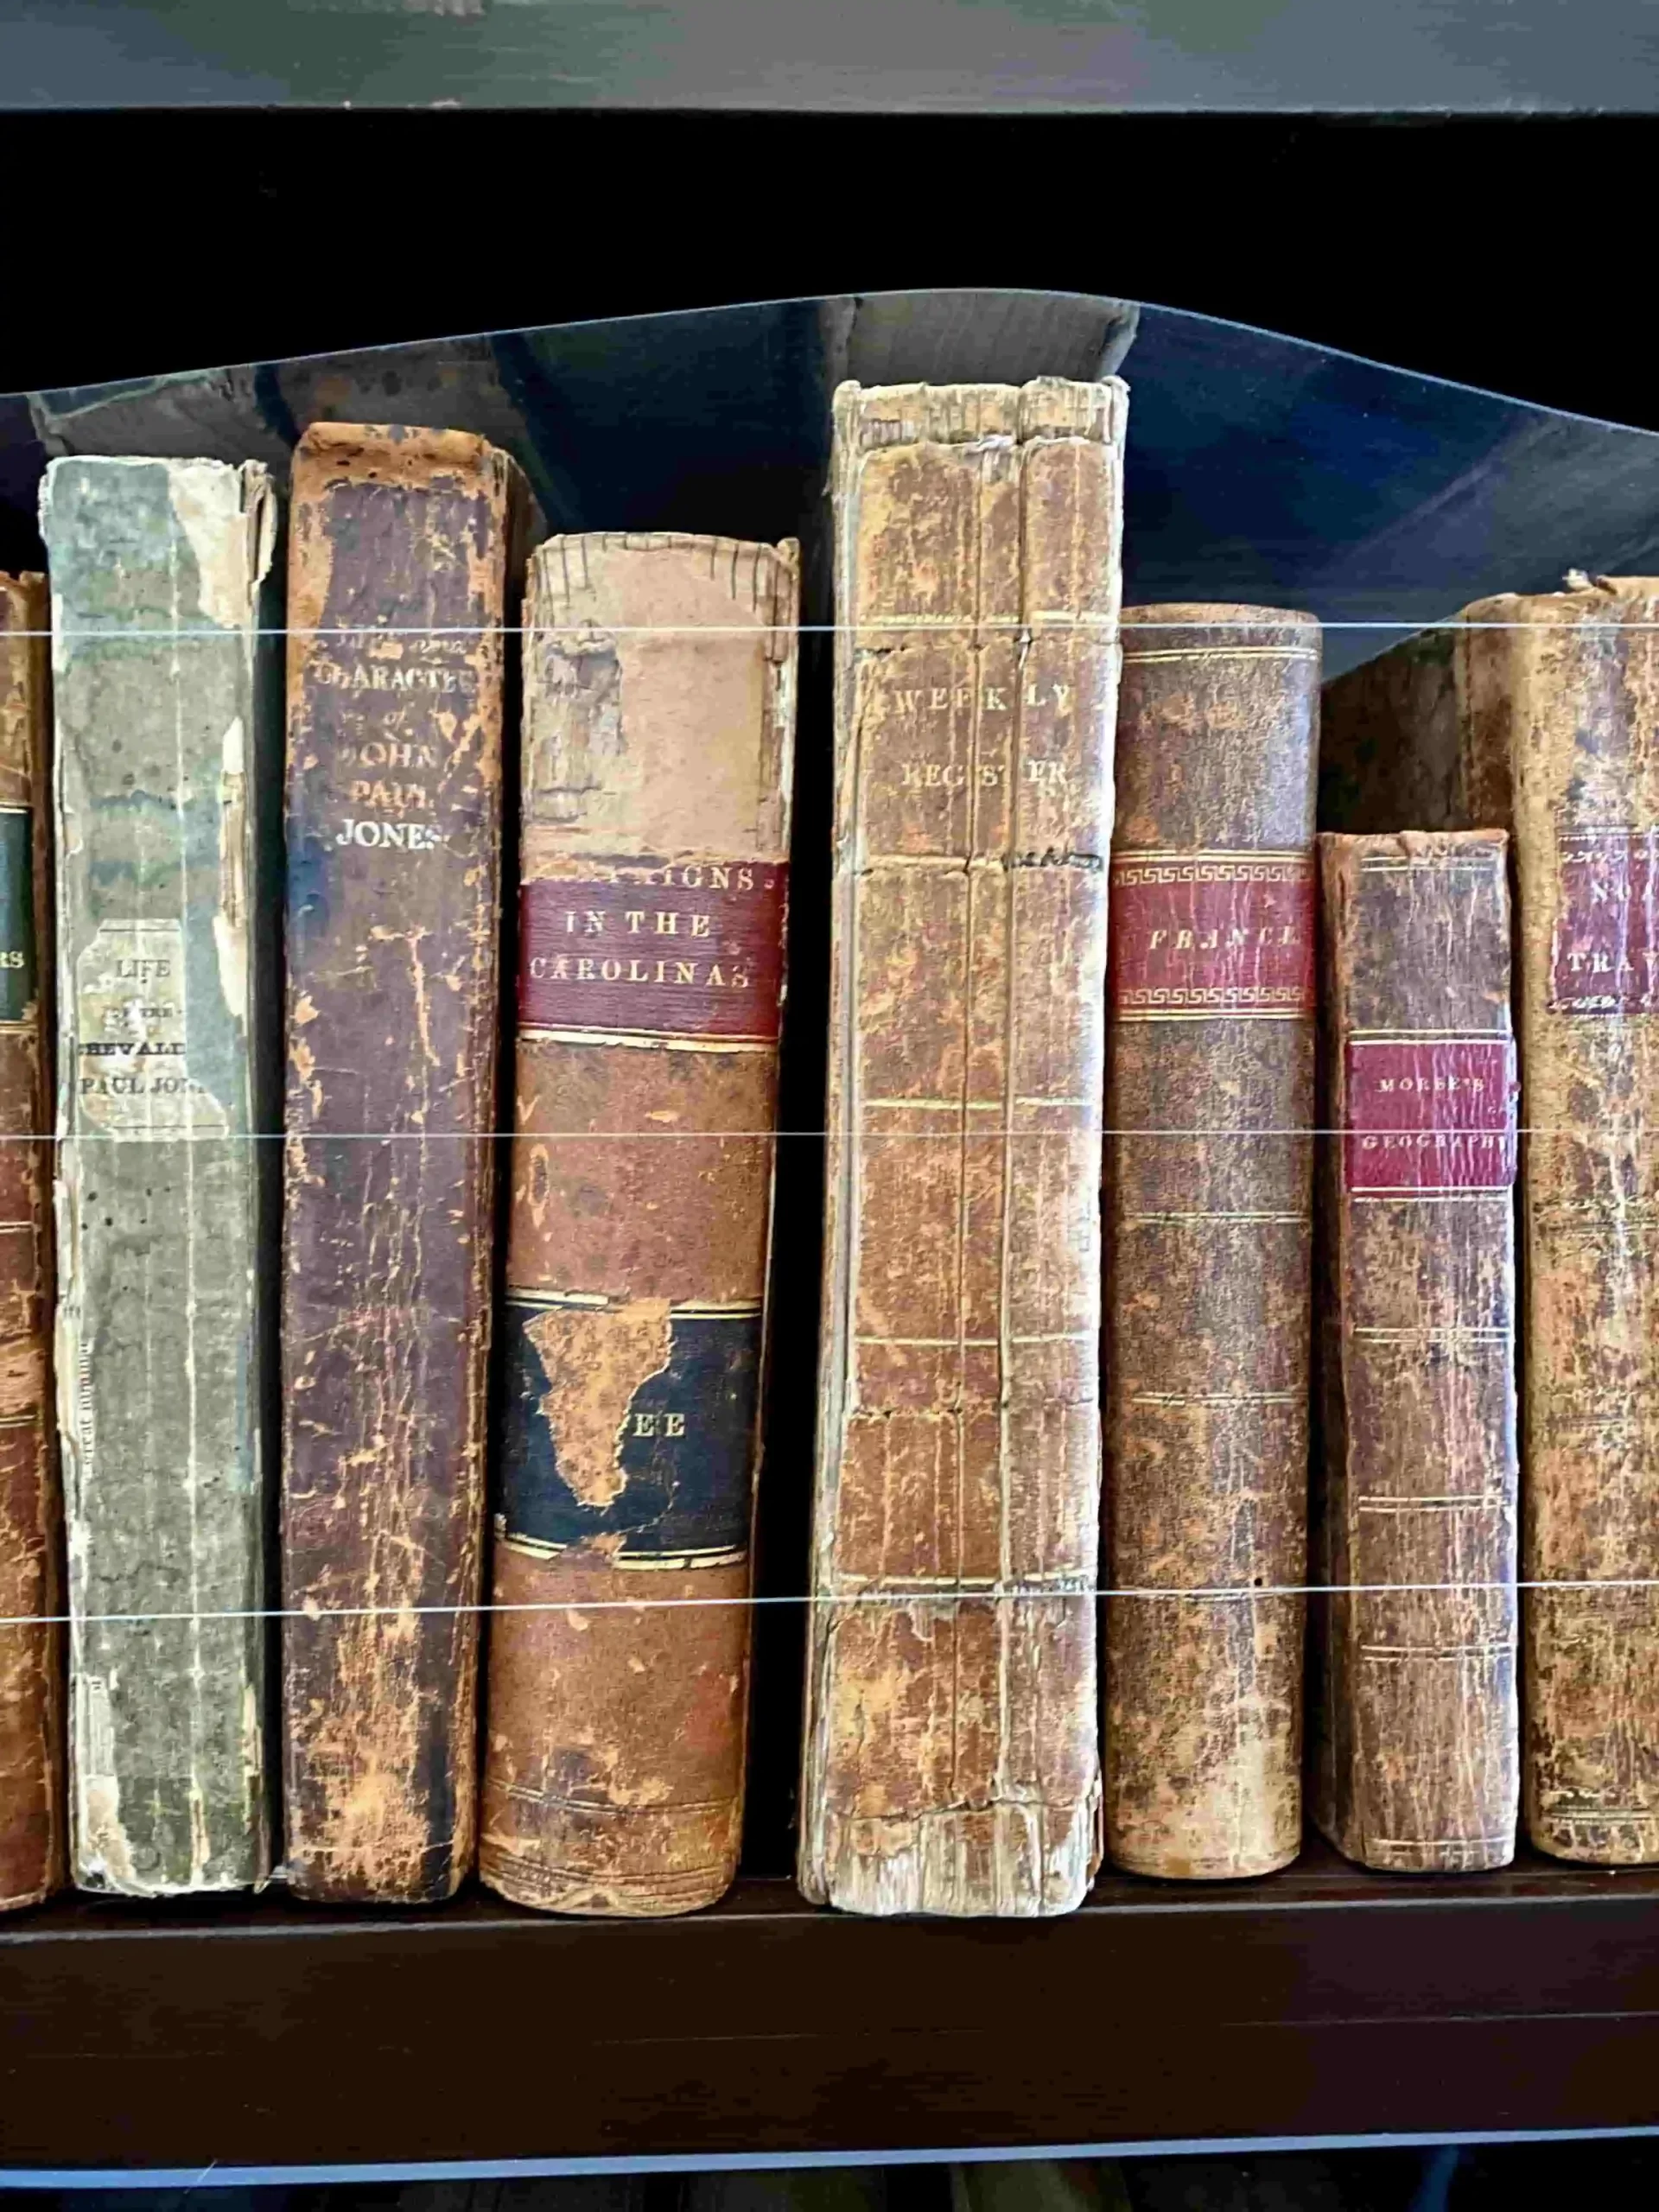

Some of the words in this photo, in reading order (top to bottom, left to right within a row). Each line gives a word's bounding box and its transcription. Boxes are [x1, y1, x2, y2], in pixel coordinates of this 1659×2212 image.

[901, 759, 1065, 787] REGSER
[566, 910, 606, 935] IN
[625, 910, 711, 938] THE
[115, 958, 171, 978] LIFE
[529, 954, 749, 988] CAROLINAS
